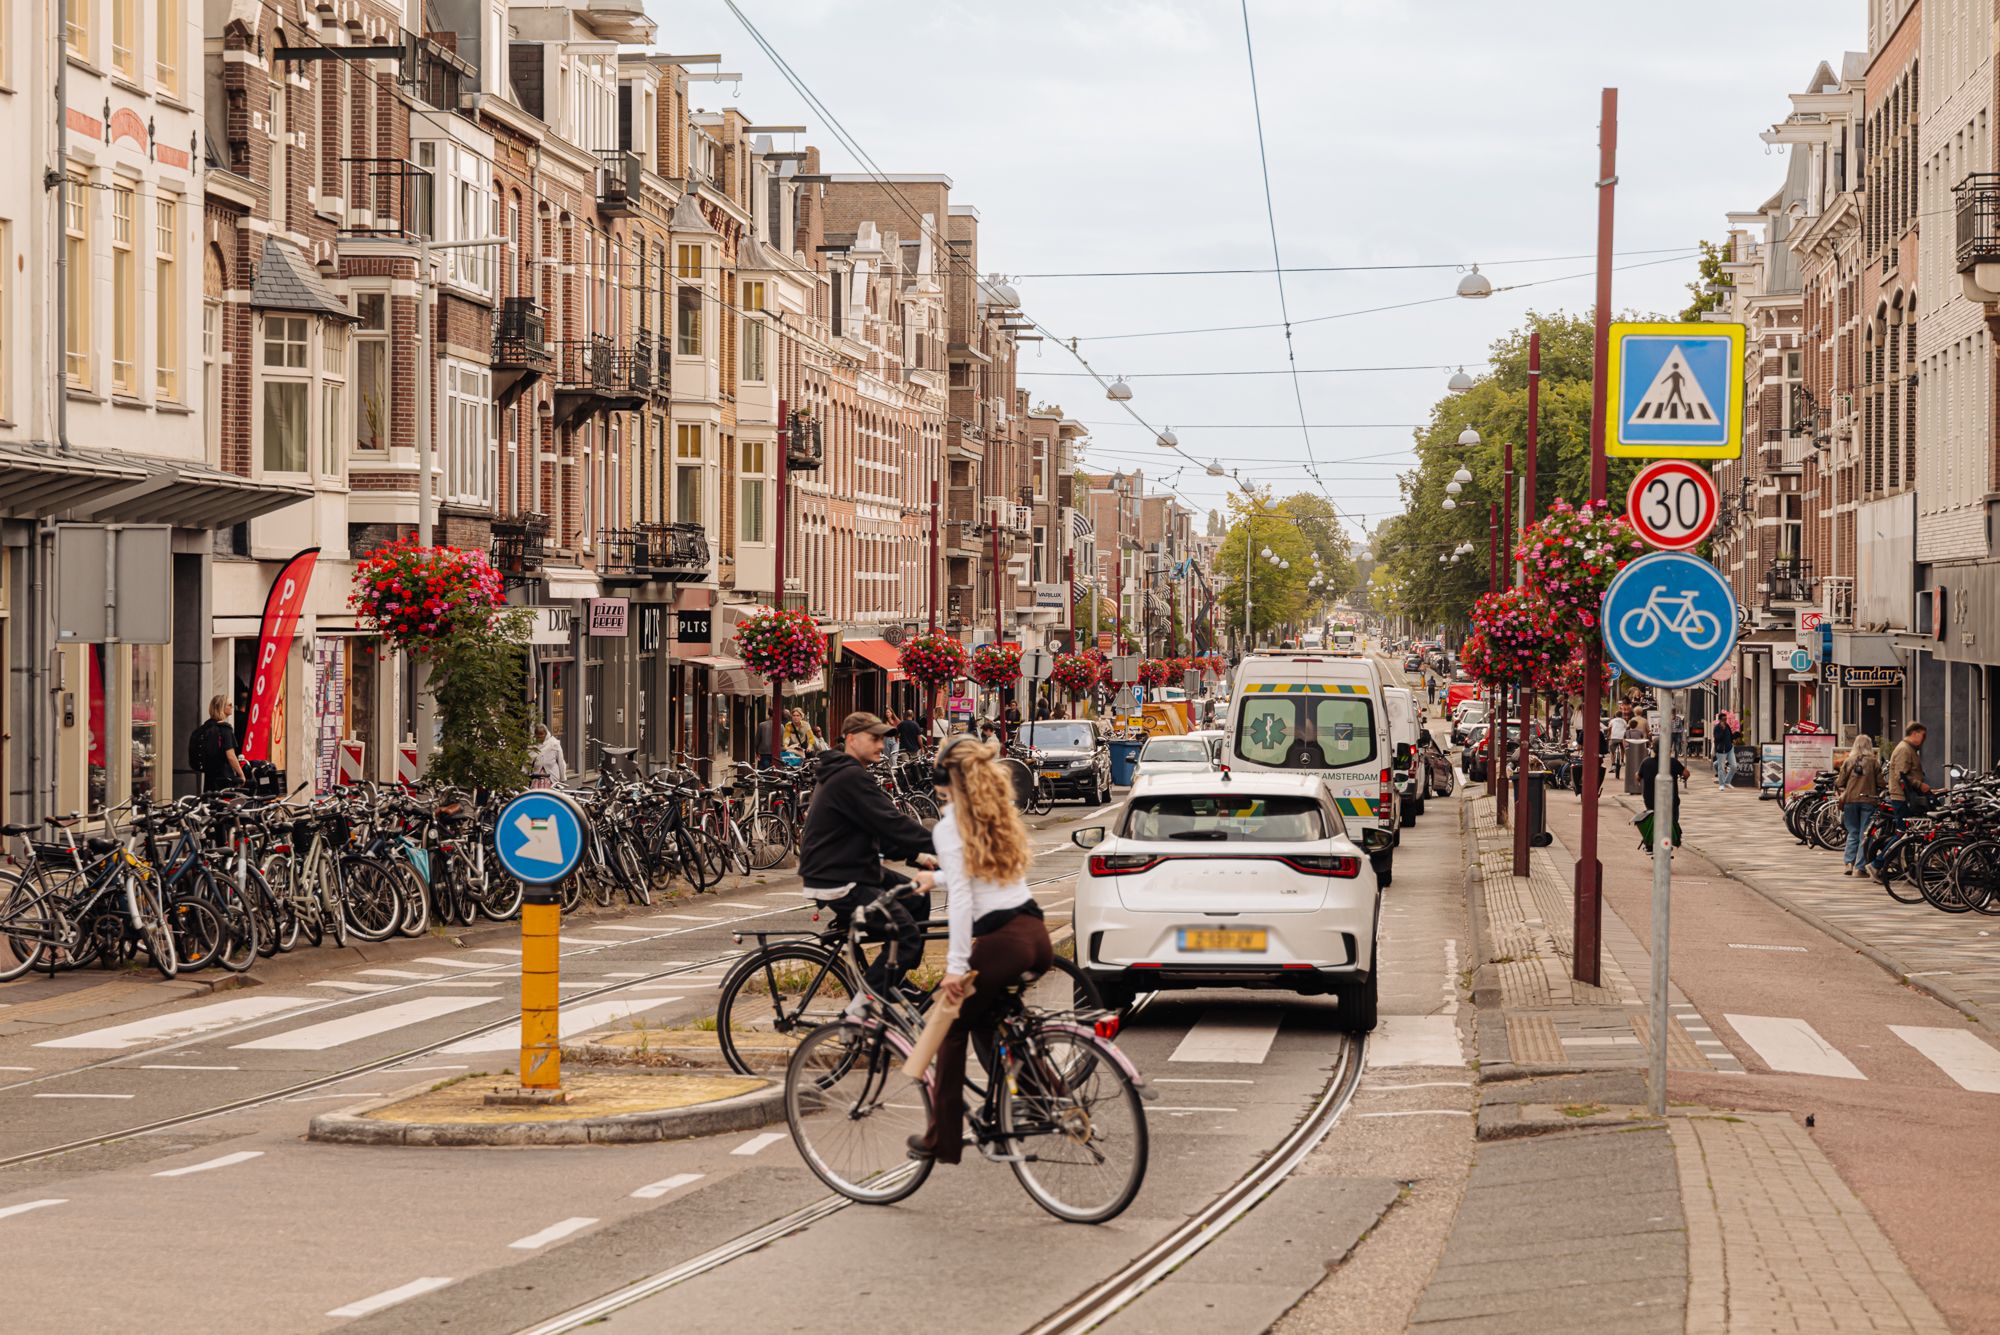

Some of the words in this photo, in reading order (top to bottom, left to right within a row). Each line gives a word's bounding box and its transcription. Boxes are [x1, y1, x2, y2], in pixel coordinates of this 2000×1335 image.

[1646, 478, 1701, 530] 30
[644, 608, 660, 650] PLTS
[679, 620, 707, 633] PLTS
[245, 577, 296, 753] pipoos
[1134, 687, 1141, 696] P
[1321, 772, 1378, 781] AMSTERDAM
